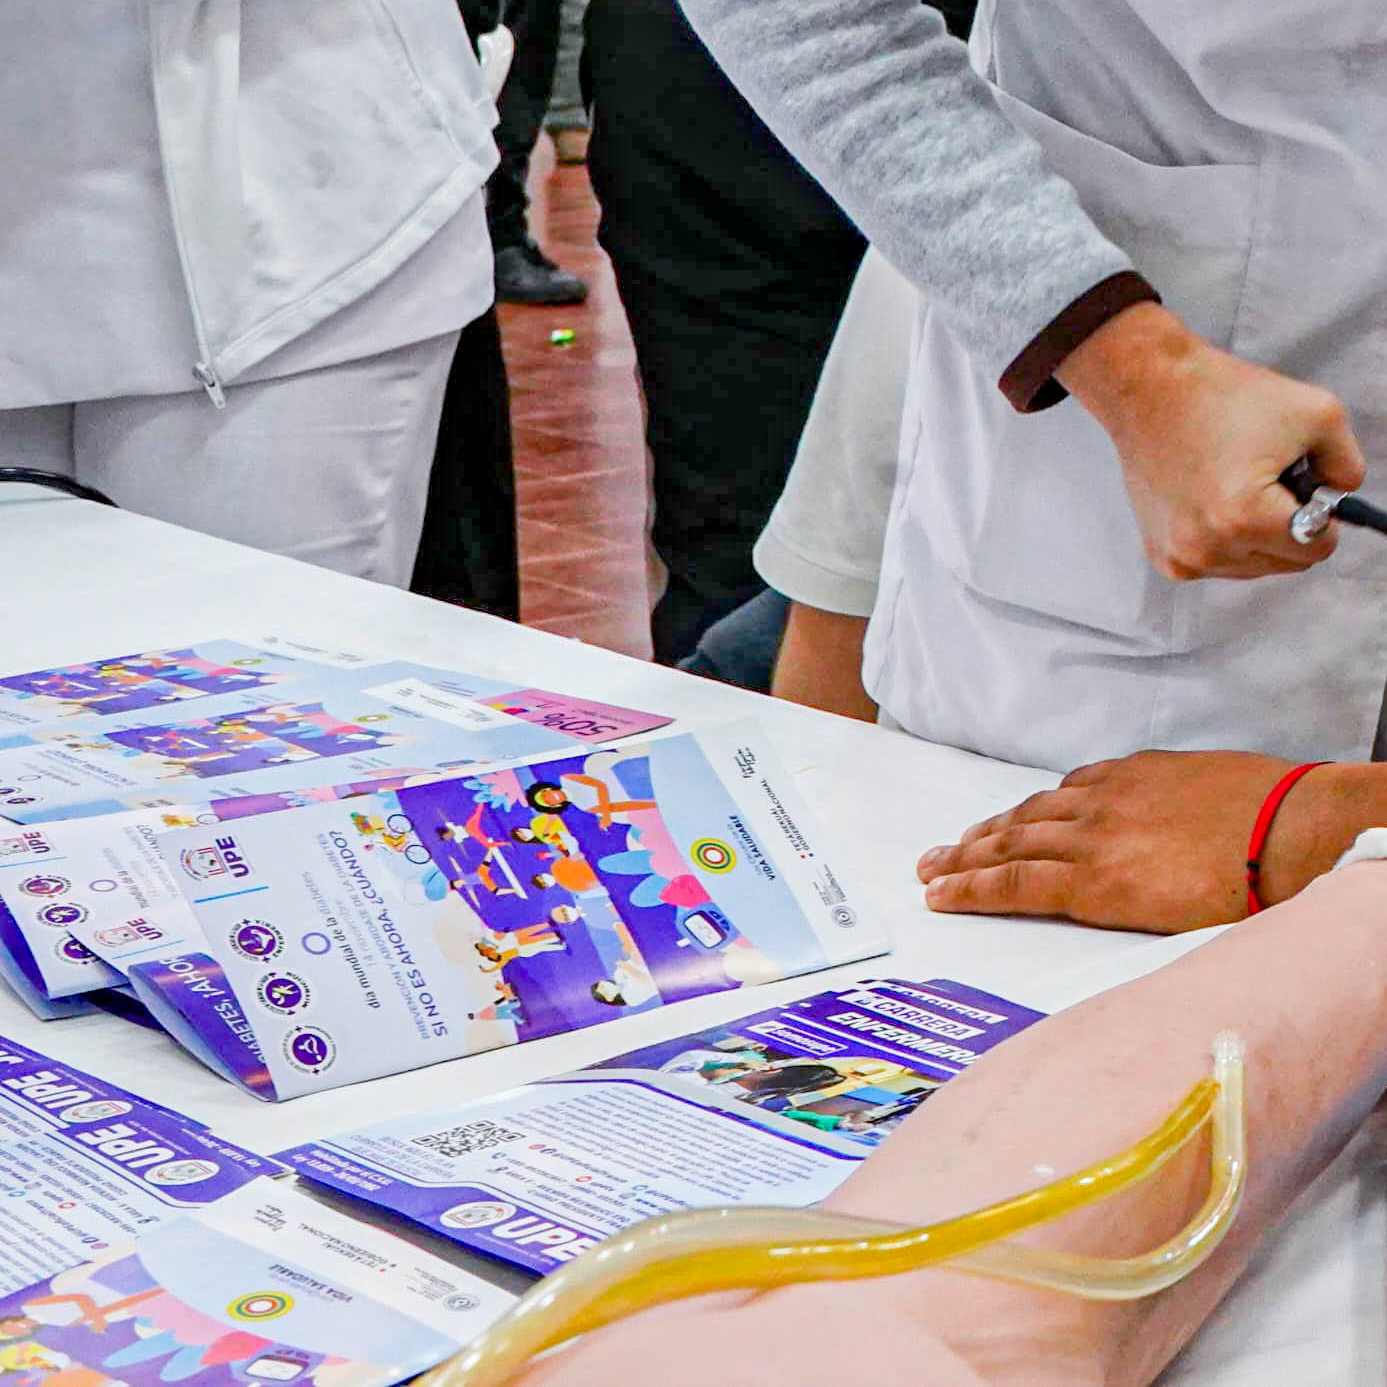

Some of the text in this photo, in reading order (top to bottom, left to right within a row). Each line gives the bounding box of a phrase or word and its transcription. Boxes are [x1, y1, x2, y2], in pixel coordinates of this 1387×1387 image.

[214, 835, 250, 878] UPE
[728, 812, 764, 859] SALUDABLE
[756, 858, 777, 880] VIDA
[127, 917, 164, 941] UPE
[323, 916, 338, 927] la
[328, 827, 450, 1036] SI NO ES AHORA, ¿CUÁNDO?
[330, 928, 346, 942] de
[337, 943, 370, 989] mundial
[827, 1011, 980, 1064] ENFERMERI
[872, 1002, 970, 1038] CARRERA
[2, 1070, 93, 1109] UPE
[77, 1123, 175, 1169] UPE
[492, 1216, 597, 1261] UPE
